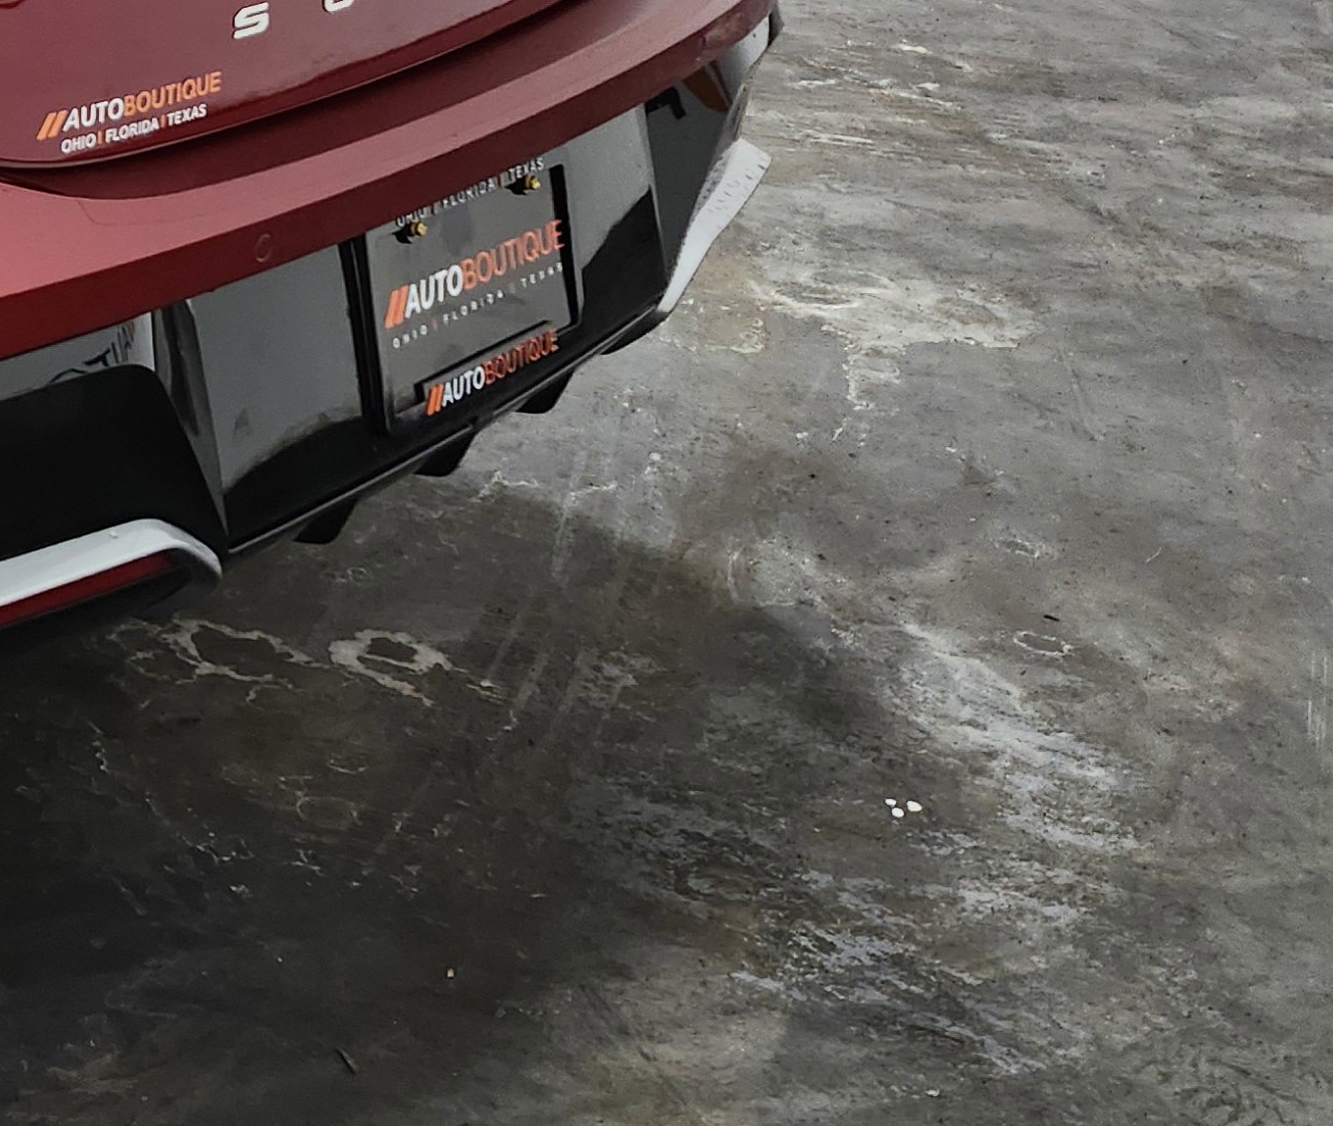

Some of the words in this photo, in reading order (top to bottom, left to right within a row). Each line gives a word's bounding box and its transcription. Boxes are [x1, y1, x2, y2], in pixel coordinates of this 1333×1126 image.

[61, 132, 97, 154] OHIO
[105, 118, 159, 143] FLORIDA
[167, 104, 207, 127] TEXAS
[508, 157, 544, 181] TEXAS
[392, 324, 428, 349] OHIO
[443, 290, 504, 325] FLORIDA
[521, 262, 563, 288] TEXAS
